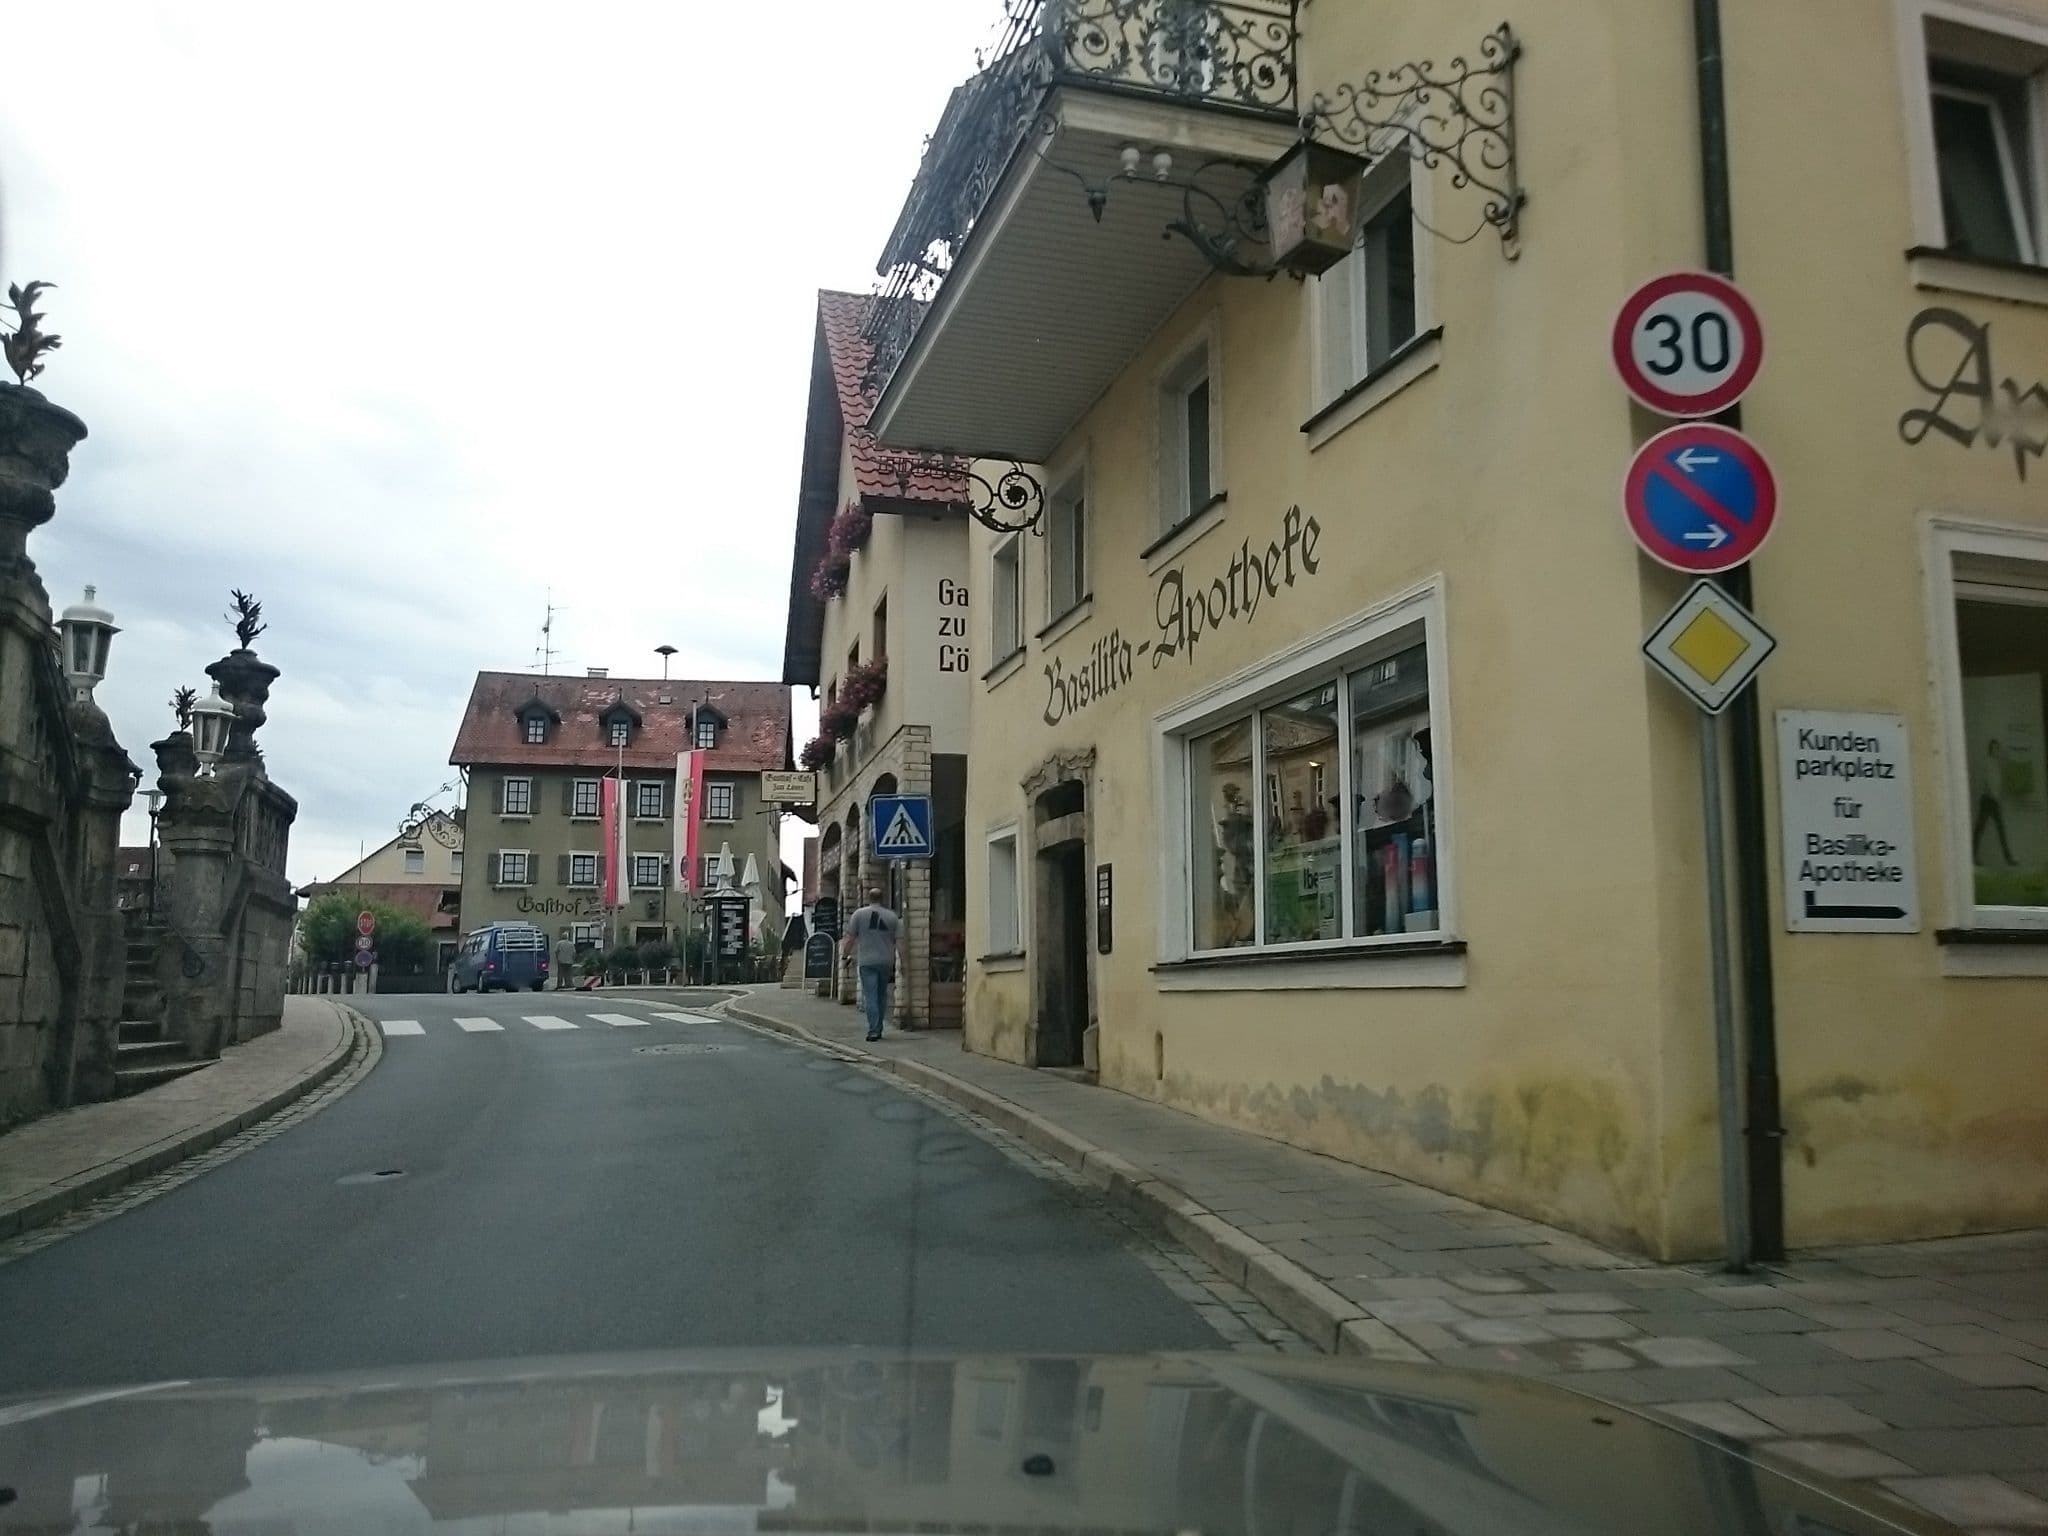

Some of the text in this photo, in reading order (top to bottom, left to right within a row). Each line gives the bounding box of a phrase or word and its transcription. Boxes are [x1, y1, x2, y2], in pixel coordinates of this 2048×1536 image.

[1644, 312, 1730, 376] 30
[1798, 728, 1880, 753] Kunden
[1796, 756, 1896, 781] parkplatz
[1833, 796, 1863, 819] für
[1806, 833, 1897, 857] Basilika-
[1798, 859, 1904, 886] Apotheke
[516, 896, 581, 916] Gasthof
